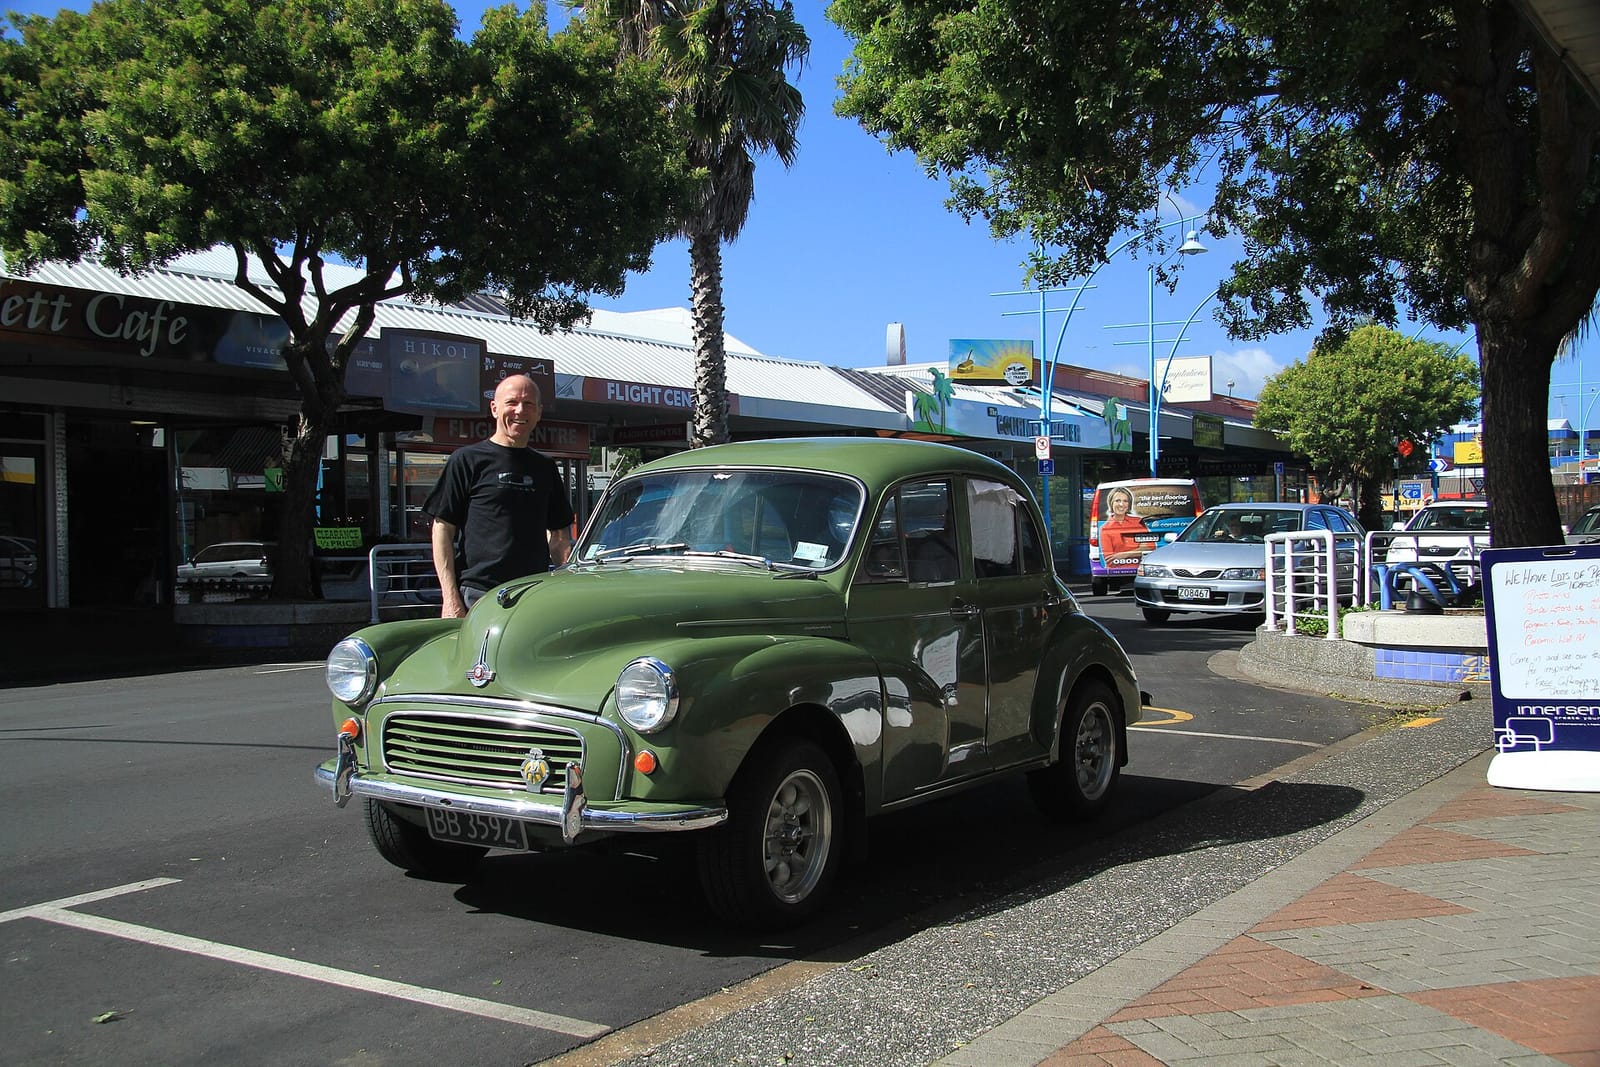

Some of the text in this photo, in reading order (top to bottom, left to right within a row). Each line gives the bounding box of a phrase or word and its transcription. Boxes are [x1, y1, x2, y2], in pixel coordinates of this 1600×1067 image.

[85, 293, 188, 357] Cafe
[606, 382, 693, 408] FLIGHT CEN
[448, 418, 492, 440] FLIG
[1164, 494, 1188, 502] flooring
[1505, 568, 1520, 586] WE
[1522, 568, 1548, 585] HAVE
[1551, 568, 1570, 583] LOTS
[1573, 569, 1585, 580] OF
[431, 808, 518, 844] BB 3592
